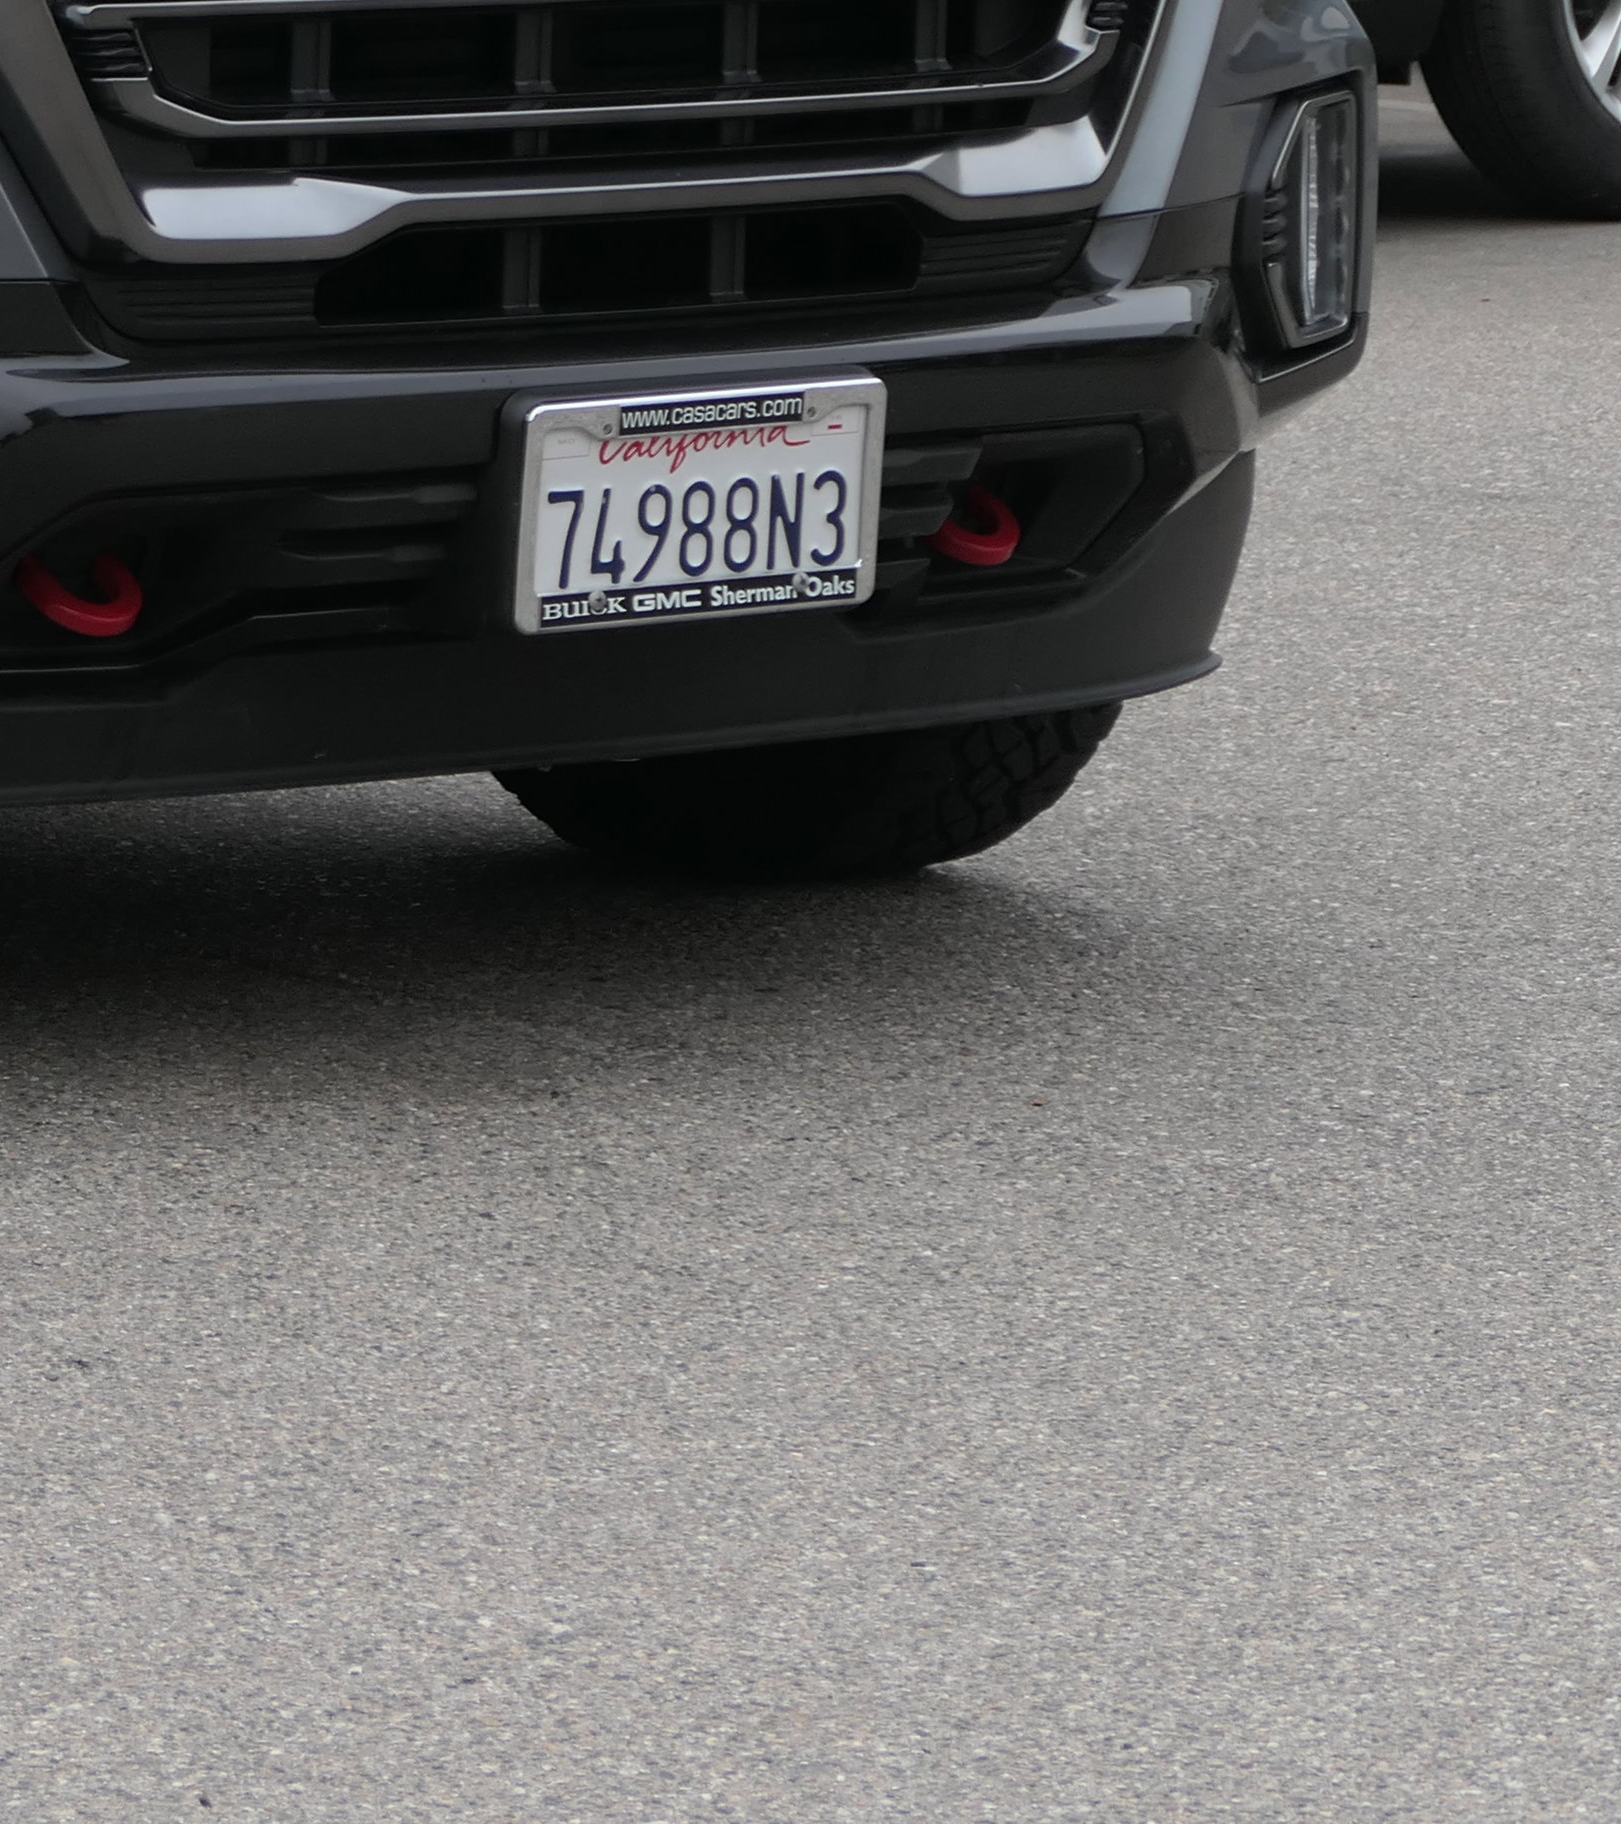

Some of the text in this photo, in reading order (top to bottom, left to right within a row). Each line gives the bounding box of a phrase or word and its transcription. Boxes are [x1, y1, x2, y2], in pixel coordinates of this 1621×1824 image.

[622, 395, 804, 429] www.casacars.com
[548, 470, 847, 590] 74988N3
[632, 589, 702, 613] GMC
[710, 584, 798, 607] Sherman
[805, 575, 855, 597] Oaks
